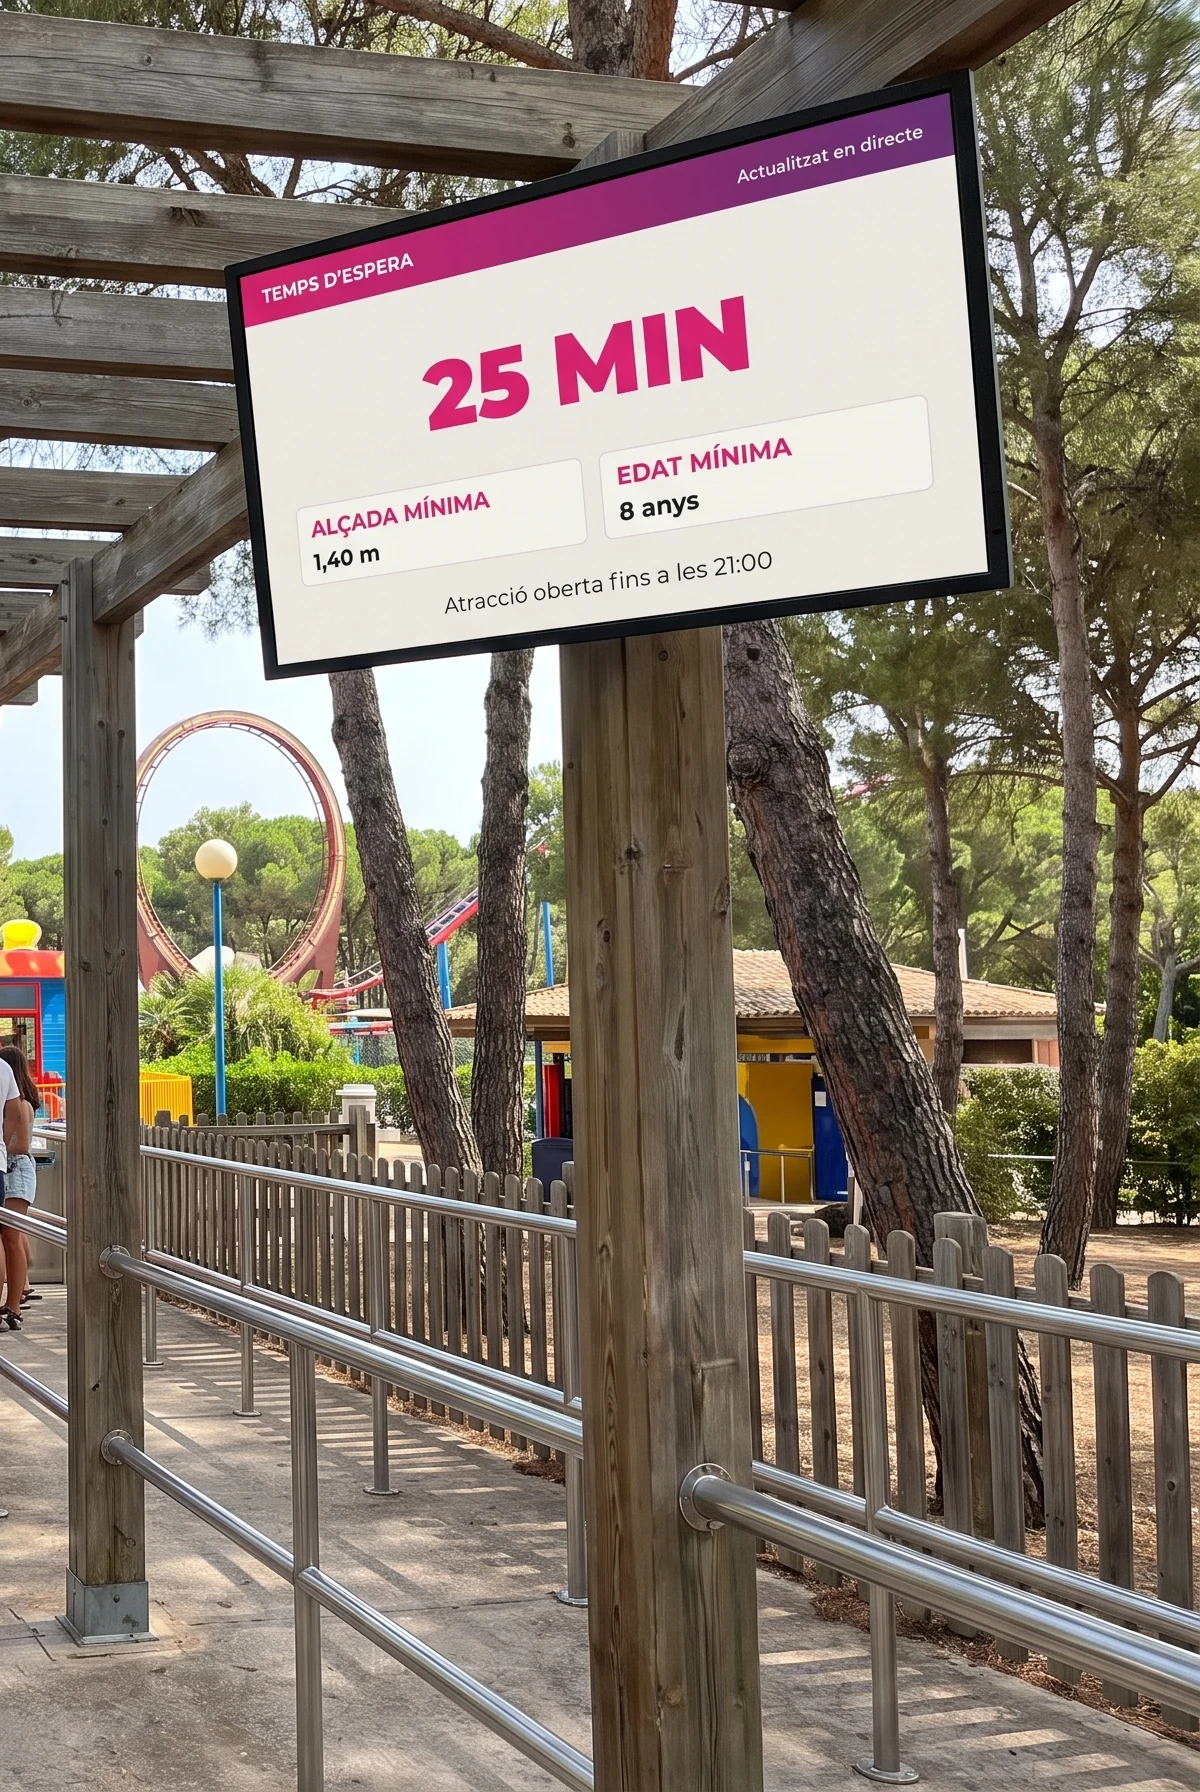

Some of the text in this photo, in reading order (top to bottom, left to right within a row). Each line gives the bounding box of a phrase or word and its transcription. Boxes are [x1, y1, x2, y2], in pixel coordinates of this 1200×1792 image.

[737, 128, 923, 184] Actualitzat en directe
[261, 252, 414, 303] TEMPS D’ESPERA
[421, 295, 750, 432] 25 MIN
[617, 437, 793, 486] EDAT MÍNIMA
[311, 491, 491, 539] ALÇADA MÍNIMA
[619, 494, 700, 521] 8 anys
[312, 547, 380, 574] 1,40 m
[444, 551, 773, 615] Atracció oberta fins a les 21:00
